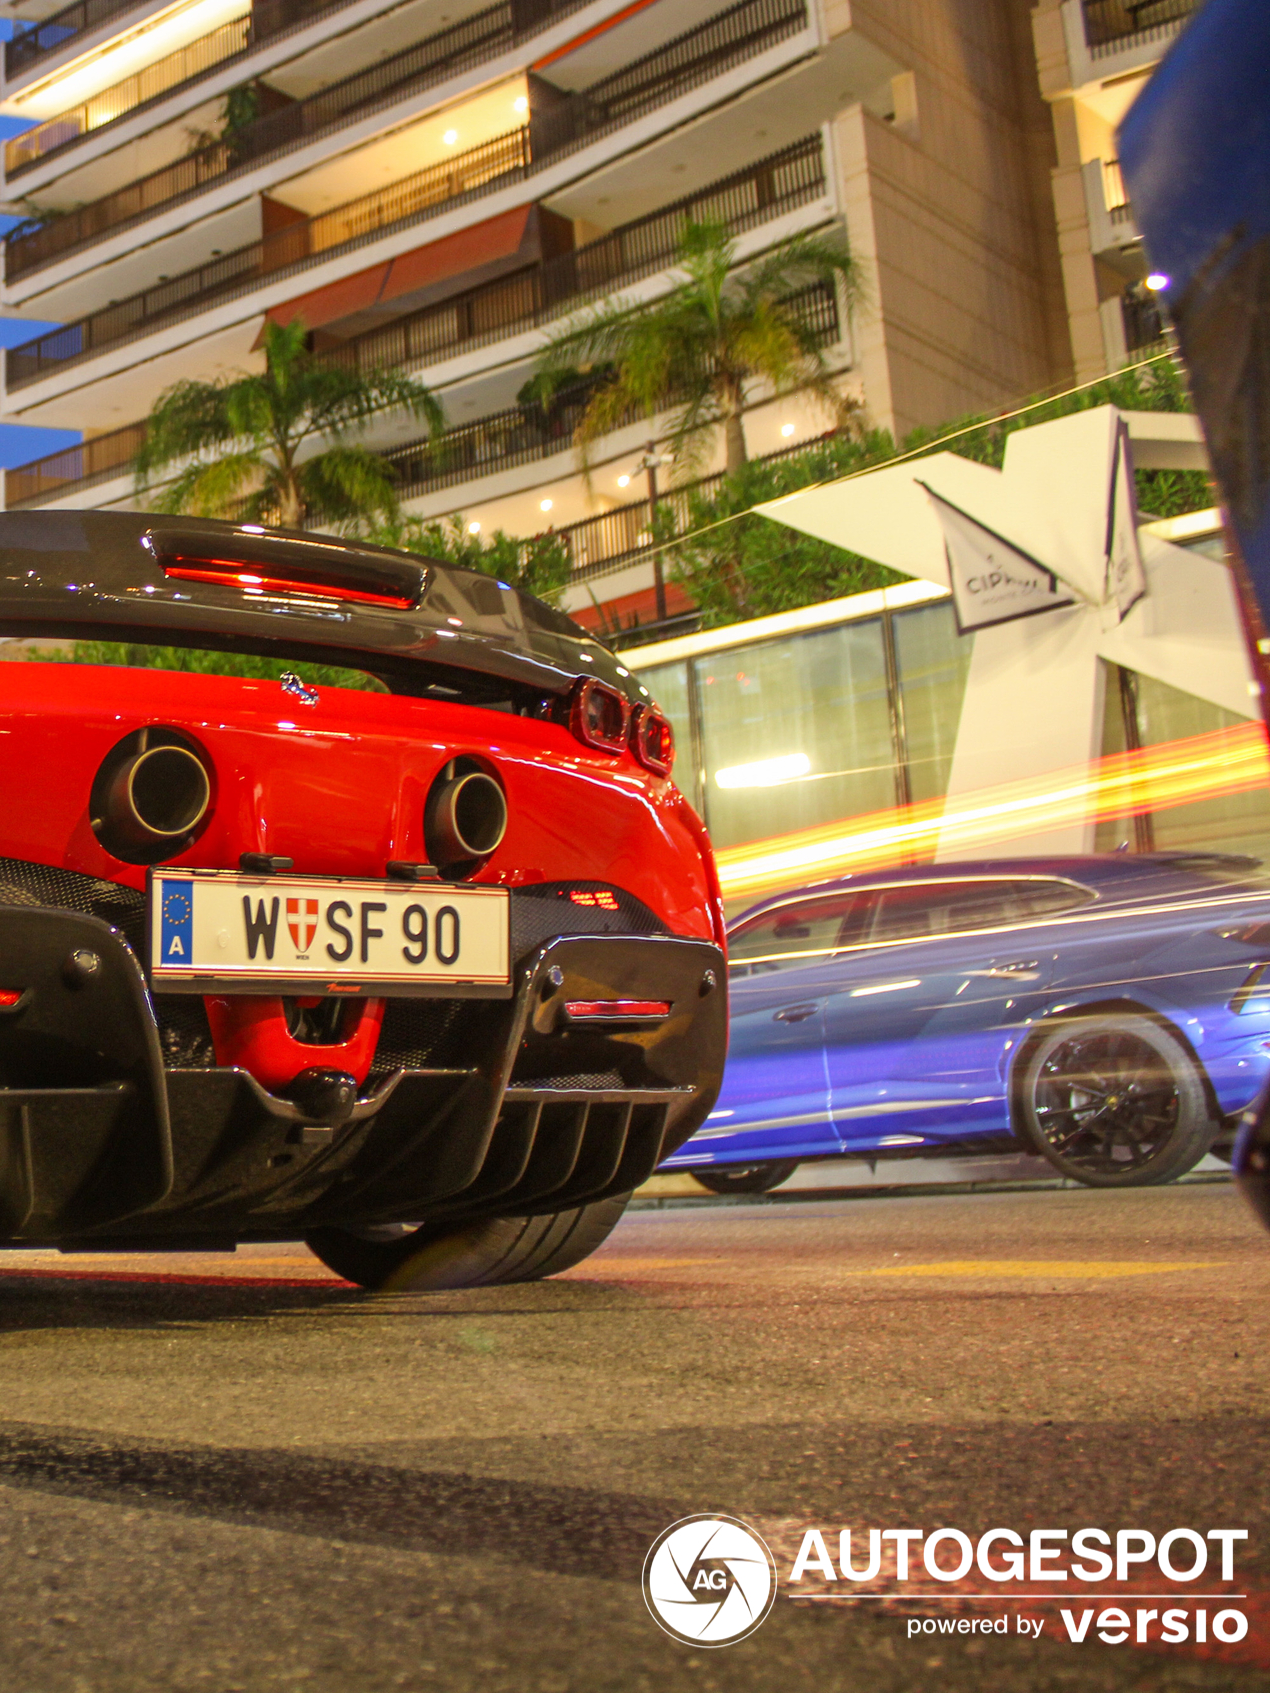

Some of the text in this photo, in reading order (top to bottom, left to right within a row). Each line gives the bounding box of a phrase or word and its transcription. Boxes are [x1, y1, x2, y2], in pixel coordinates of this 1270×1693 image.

[168, 935, 185, 955] A
[243, 895, 460, 965] W SF 90
